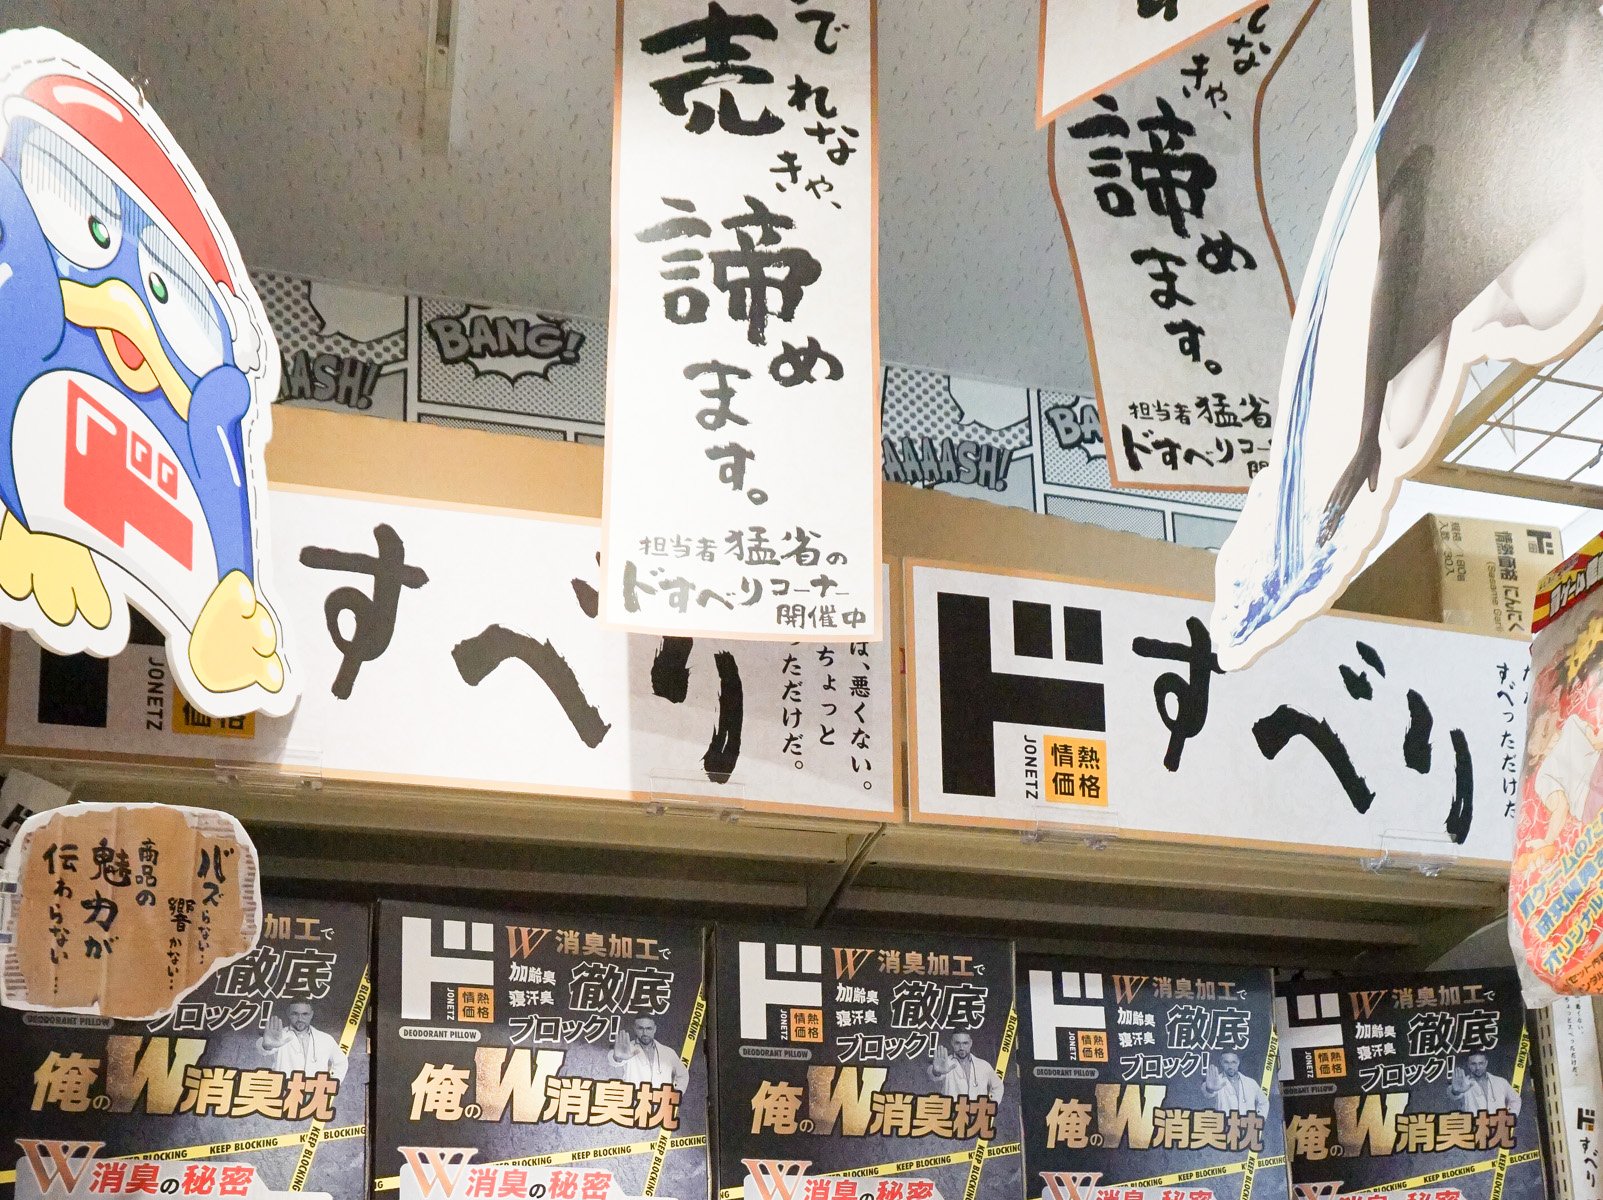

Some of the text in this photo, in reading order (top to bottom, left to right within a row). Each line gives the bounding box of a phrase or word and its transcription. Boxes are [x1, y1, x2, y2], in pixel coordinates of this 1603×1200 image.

[425, 312, 588, 367] BANG!
[280, 349, 384, 410] ASH!
[1045, 404, 1104, 449] BA
[638, 526, 849, 567] 担当者猛省の
[776, 602, 867, 629] 開催中
[145, 656, 165, 732] JONETZ
[781, 642, 805, 770] ただけだ。
[1024, 735, 1039, 800] JONETZ
[135, 837, 160, 907] 商品の
[81, 838, 133, 961] 魅力が
[568, 961, 675, 1015] 徹底
[890, 979, 989, 1030] 徹底
[403, 1028, 478, 1040] DEODORANT PILLOW
[1165, 1003, 1251, 1050] 徹底
[1407, 1009, 1500, 1057] 徹底
[30, 1035, 340, 1121] 俺のW消臭枕
[409, 1046, 683, 1130] 俺のW消臭枕
[751, 1065, 998, 1140] 俺のW消臭枕
[669, 1135, 707, 1149] BLOCKING
[1045, 1083, 1265, 1151] 俺のW消臭枕
[209, 1137, 280, 1155] KEEP BLOCKING
[571, 1145, 632, 1161] KEEP BLOCKING
[896, 1155, 952, 1172] KEEP BLOCKING
[1195, 1166, 1228, 1180] BLOCKING
